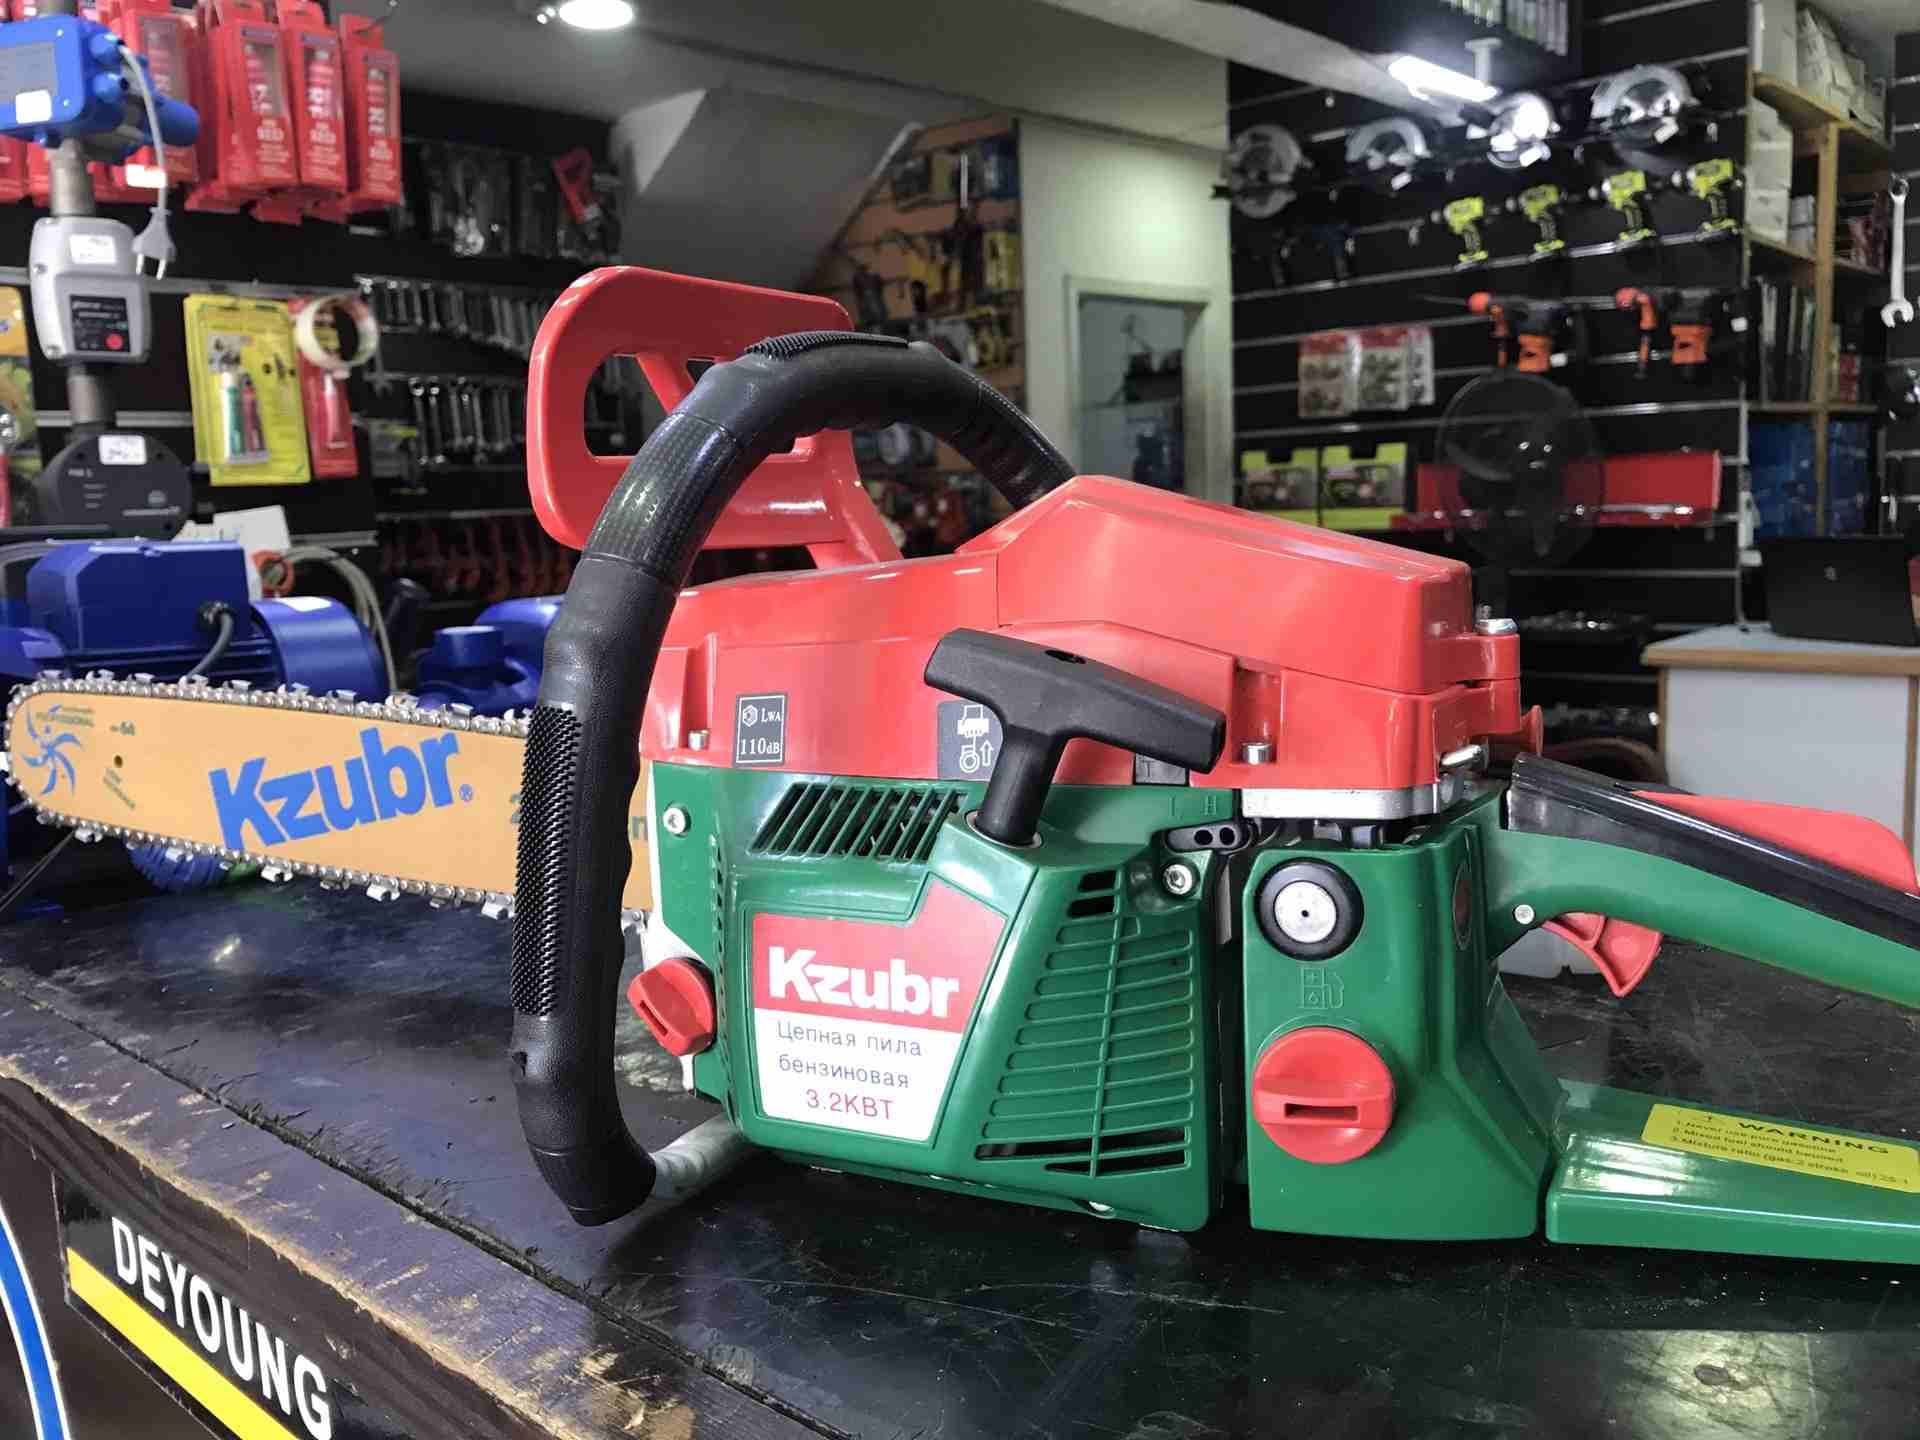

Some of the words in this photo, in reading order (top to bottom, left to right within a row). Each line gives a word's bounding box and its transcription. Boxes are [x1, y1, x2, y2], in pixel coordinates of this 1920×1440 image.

[741, 737, 780, 755] 110dB
[208, 727, 460, 851] Kzubr
[768, 946, 960, 1019] Kzubr
[777, 1020, 857, 1047] Цепная
[867, 1034, 923, 1058] пила
[778, 1053, 910, 1089] бензиновая
[1738, 1121, 1889, 1154] WARNING
[111, 1216, 332, 1440] DEYOUNG
